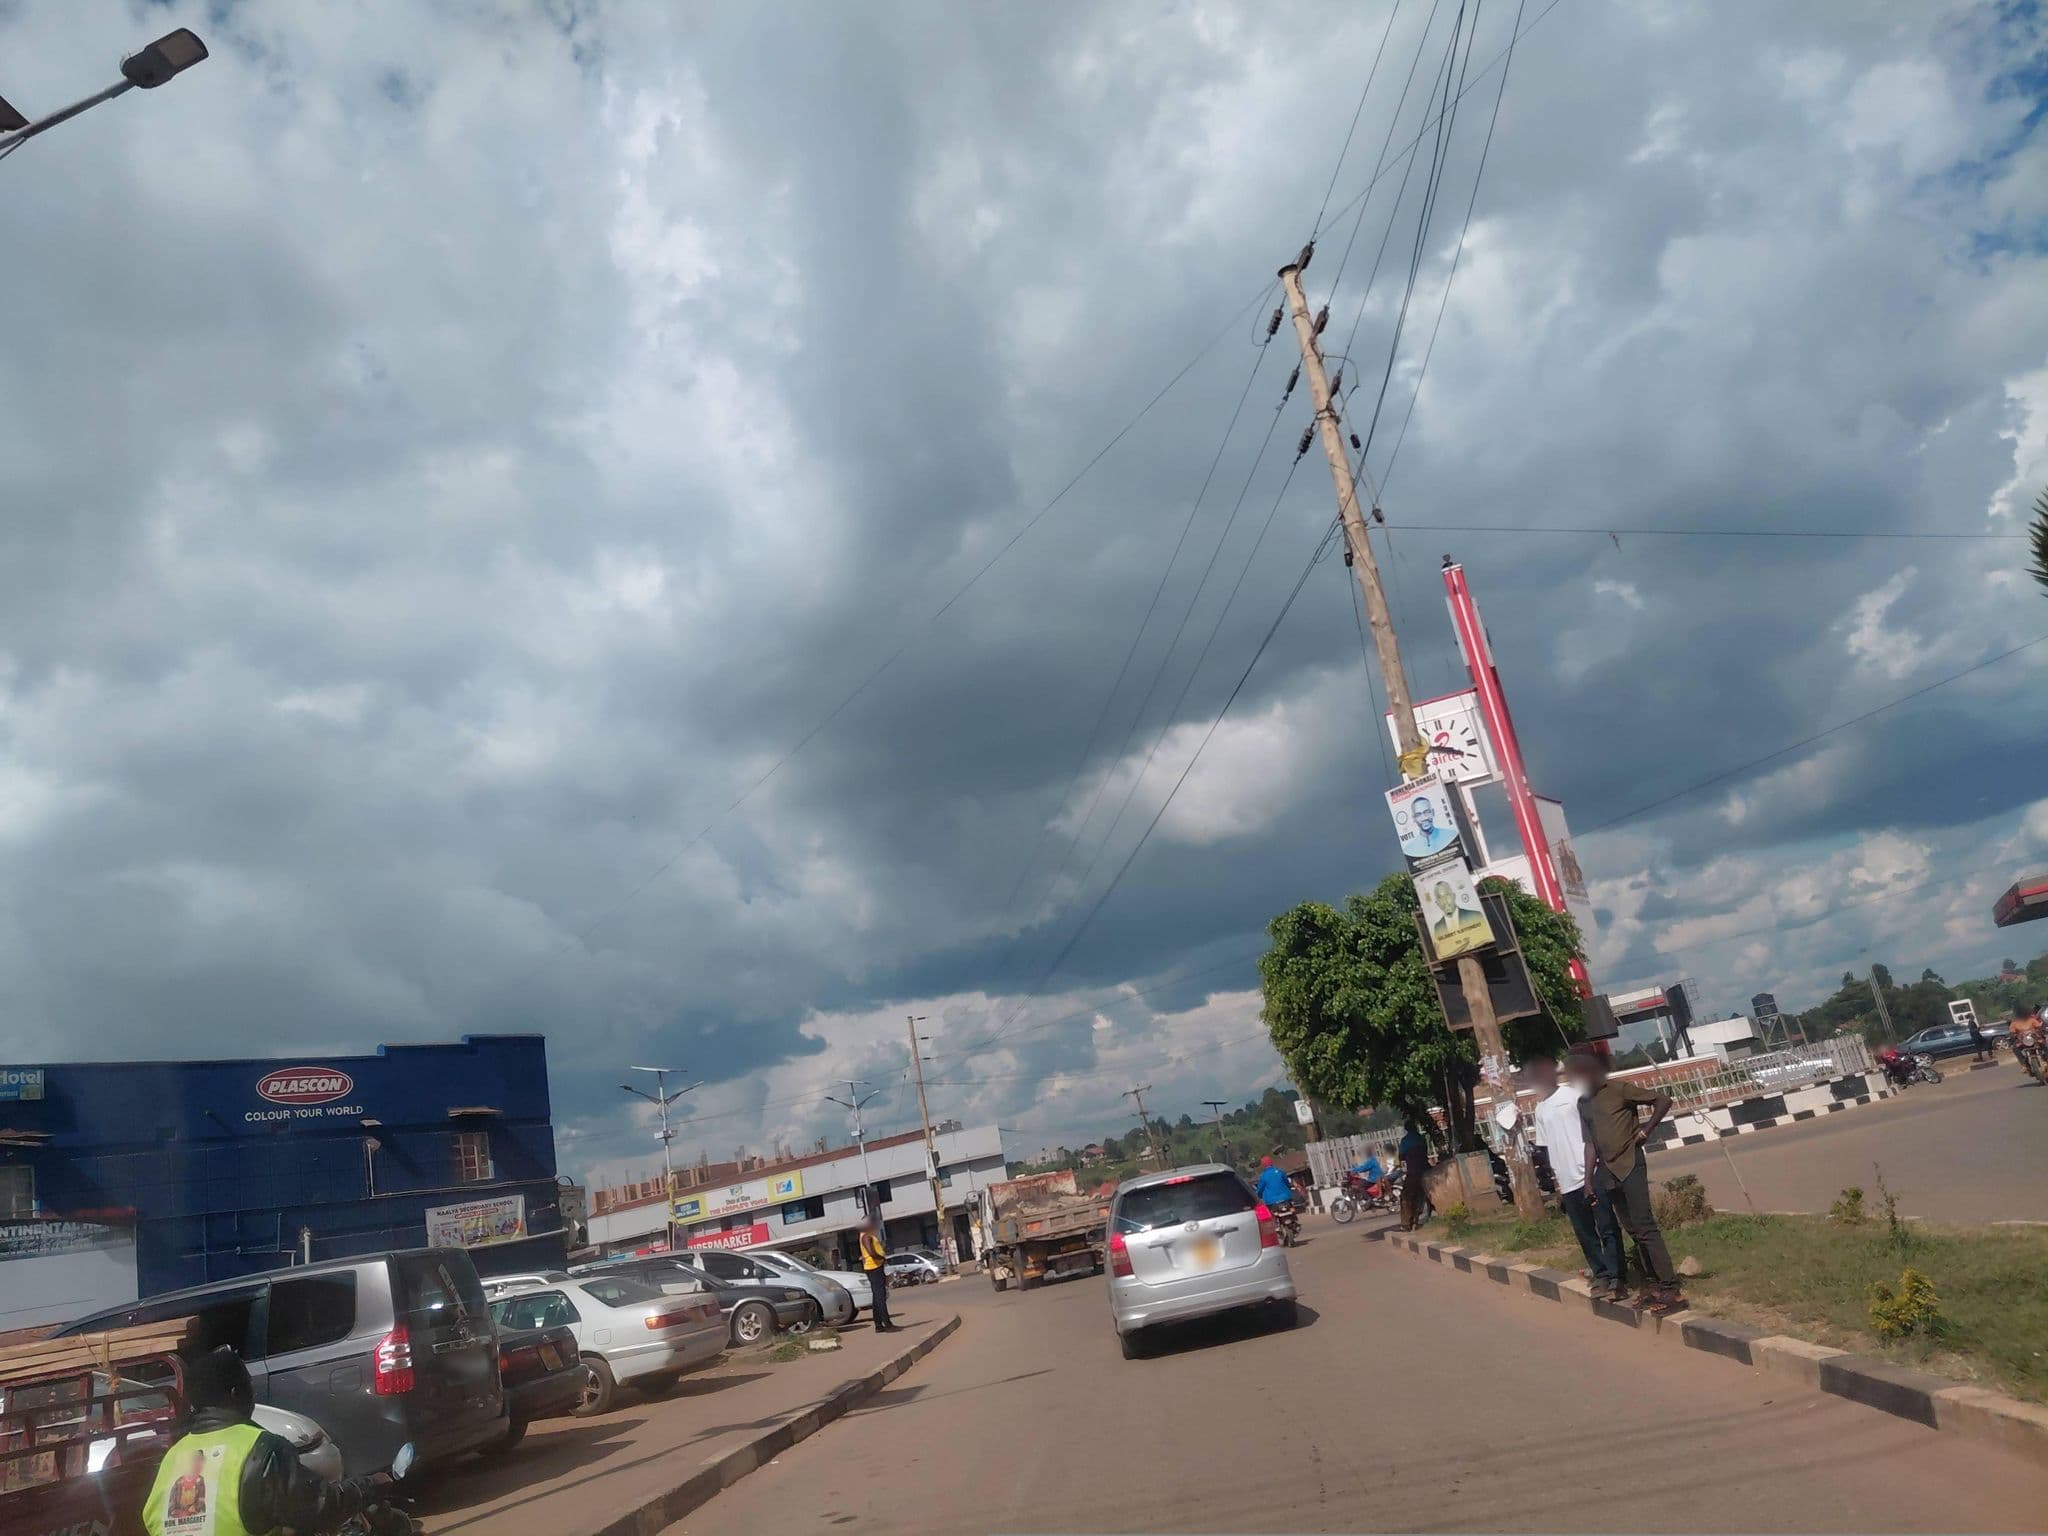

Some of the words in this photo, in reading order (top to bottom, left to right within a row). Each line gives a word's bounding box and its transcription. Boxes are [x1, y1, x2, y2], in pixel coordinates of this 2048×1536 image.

[1400, 832, 1415, 842] VOTE
[268, 1078, 342, 1094] PLASCON
[244, 1109, 291, 1122] COLOUR
[293, 1108, 323, 1118] YOUR
[326, 1106, 363, 1116] WORLD
[459, 1203, 492, 1213] SECONDARY
[492, 1199, 514, 1207] SCHOOL
[687, 1232, 752, 1250] UPERMARKET
[177, 1515, 206, 1526] MARGARET
